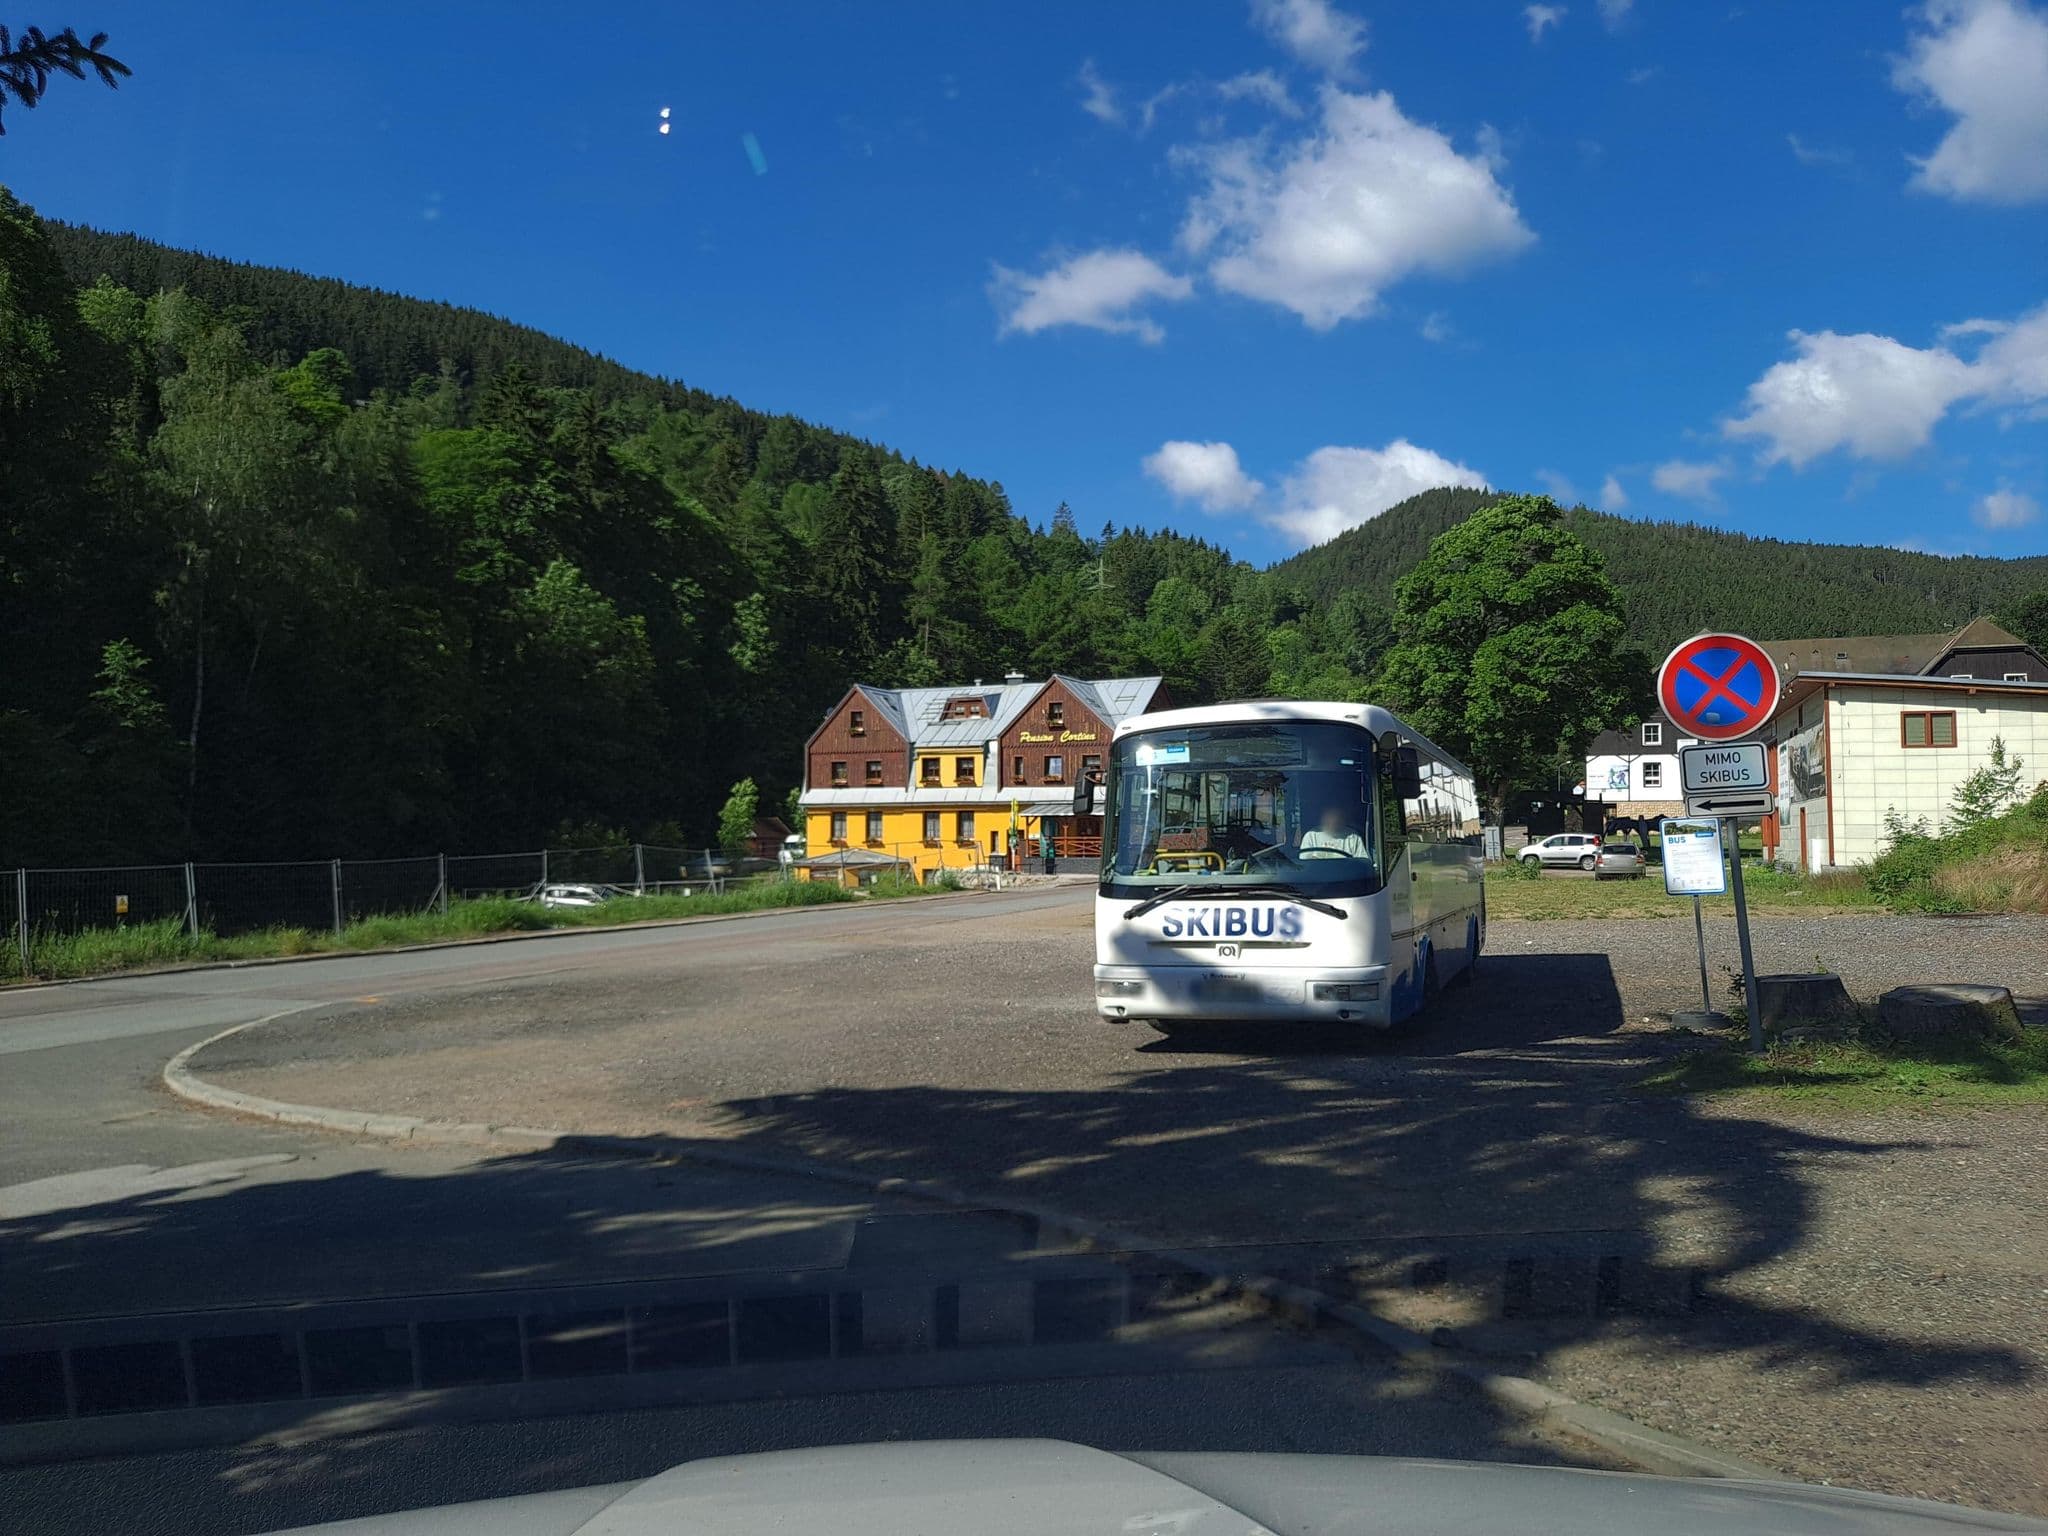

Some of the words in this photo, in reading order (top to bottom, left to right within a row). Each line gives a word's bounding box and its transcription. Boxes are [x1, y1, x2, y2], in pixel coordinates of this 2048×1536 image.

[1060, 730, 1097, 743] Cortina
[1705, 752, 1741, 766] MIMO
[1700, 768, 1750, 783] SKIBUS
[1668, 836, 1686, 844] BUS
[1162, 906, 1304, 937] SKIBUS
